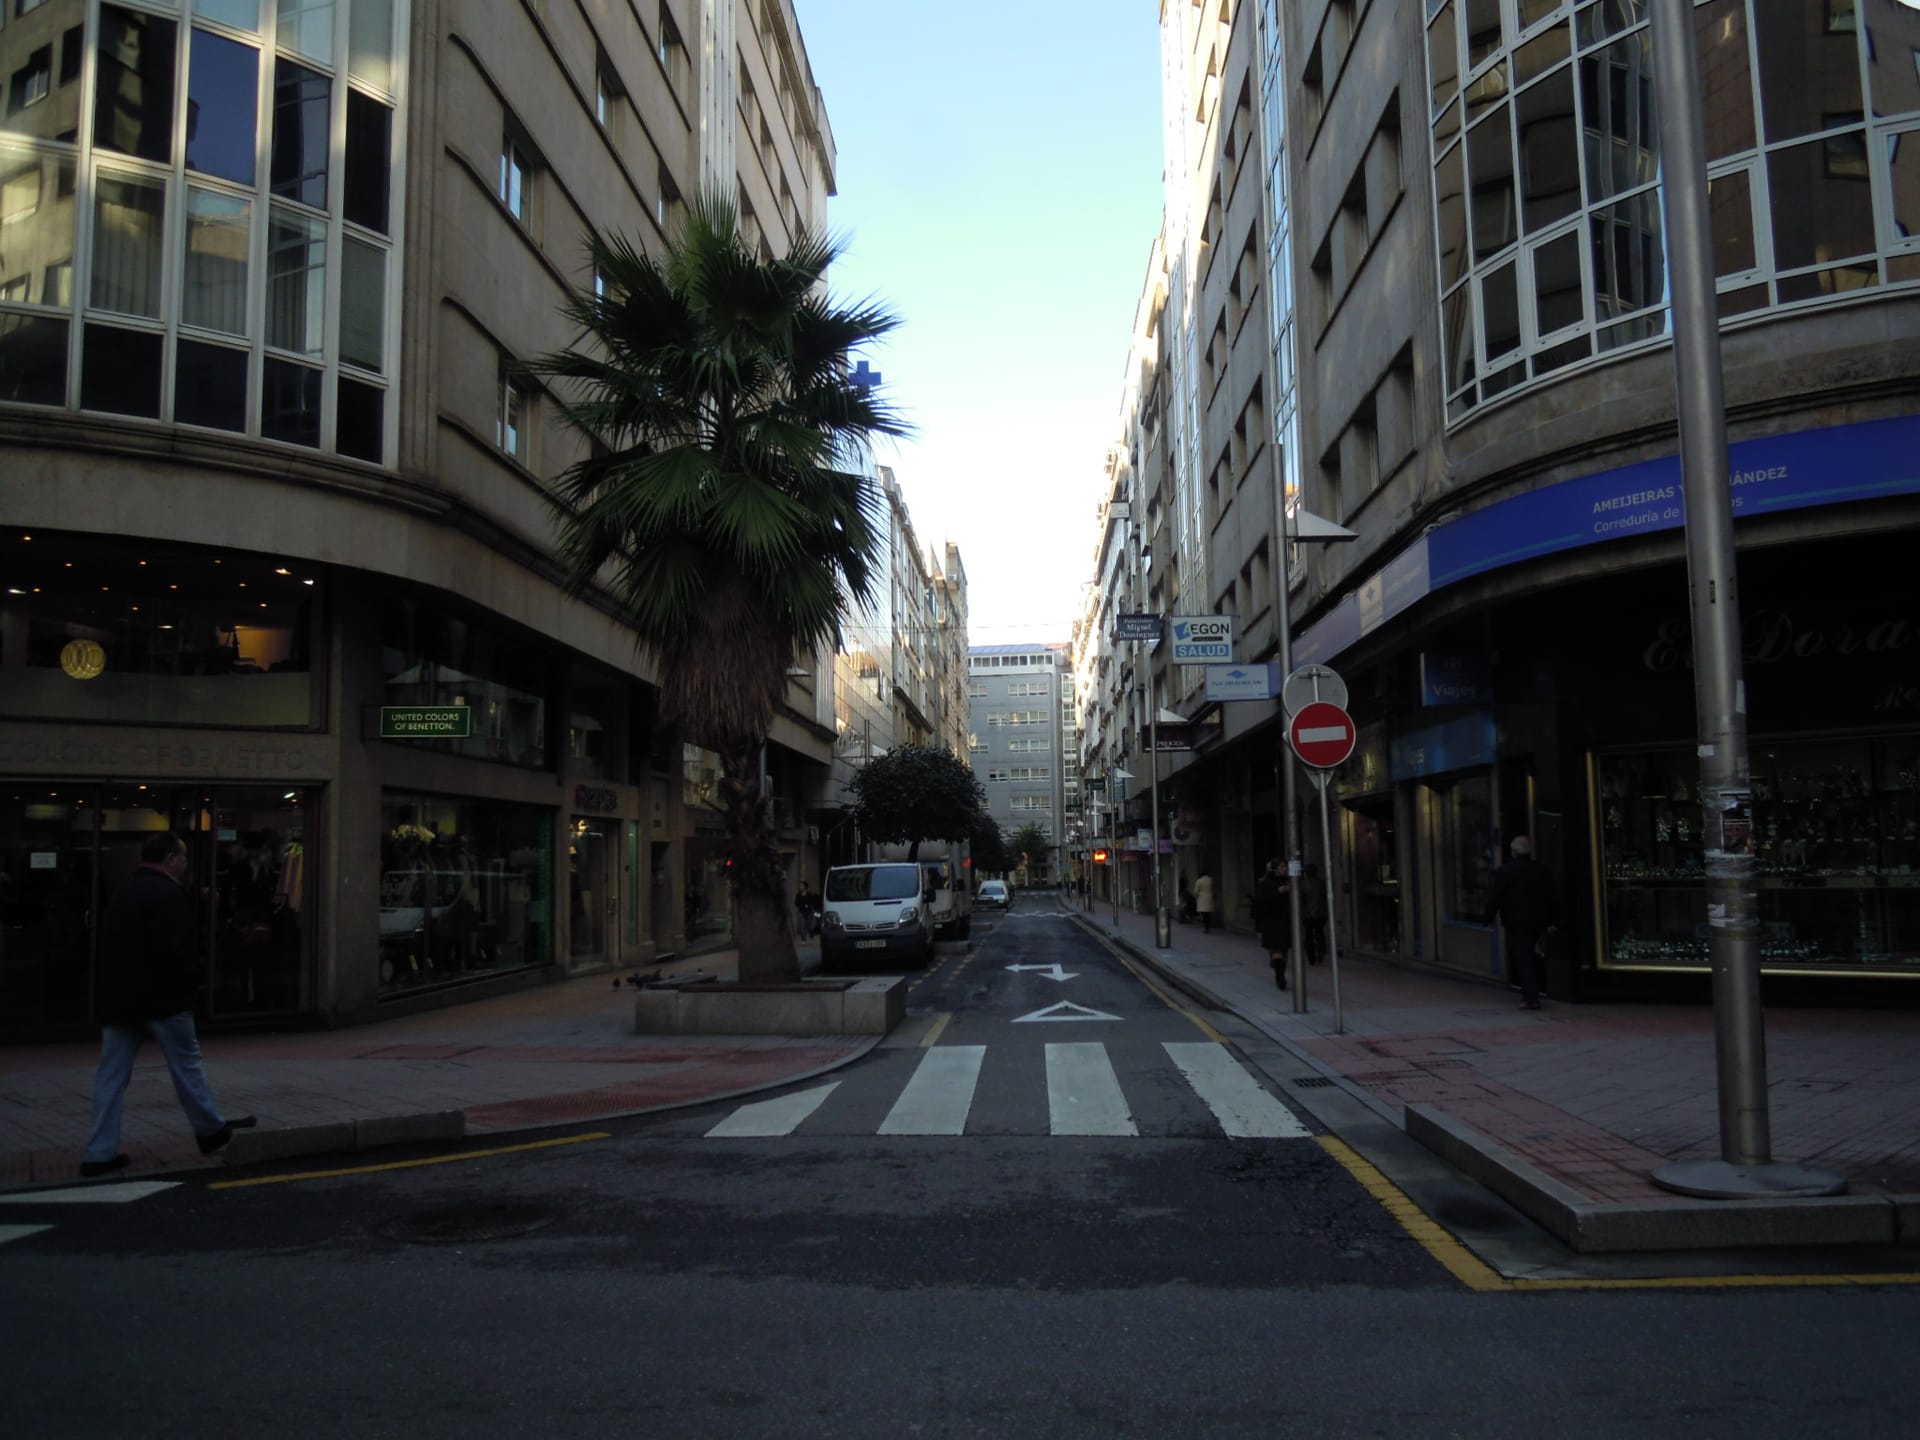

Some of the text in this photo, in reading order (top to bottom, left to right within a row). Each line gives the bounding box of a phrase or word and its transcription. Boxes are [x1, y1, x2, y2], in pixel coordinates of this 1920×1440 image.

[1593, 486, 1675, 513] AMEIJEIRAS
[1729, 465, 1788, 487] ÁNDEZ
[1593, 507, 1681, 533] Correduría de
[1180, 622, 1230, 636] AEGON
[1178, 645, 1227, 657] SALUD
[1432, 682, 1477, 698] Viajes
[391, 712, 460, 721] UNITED COLORS
[394, 722, 406, 731] OF
